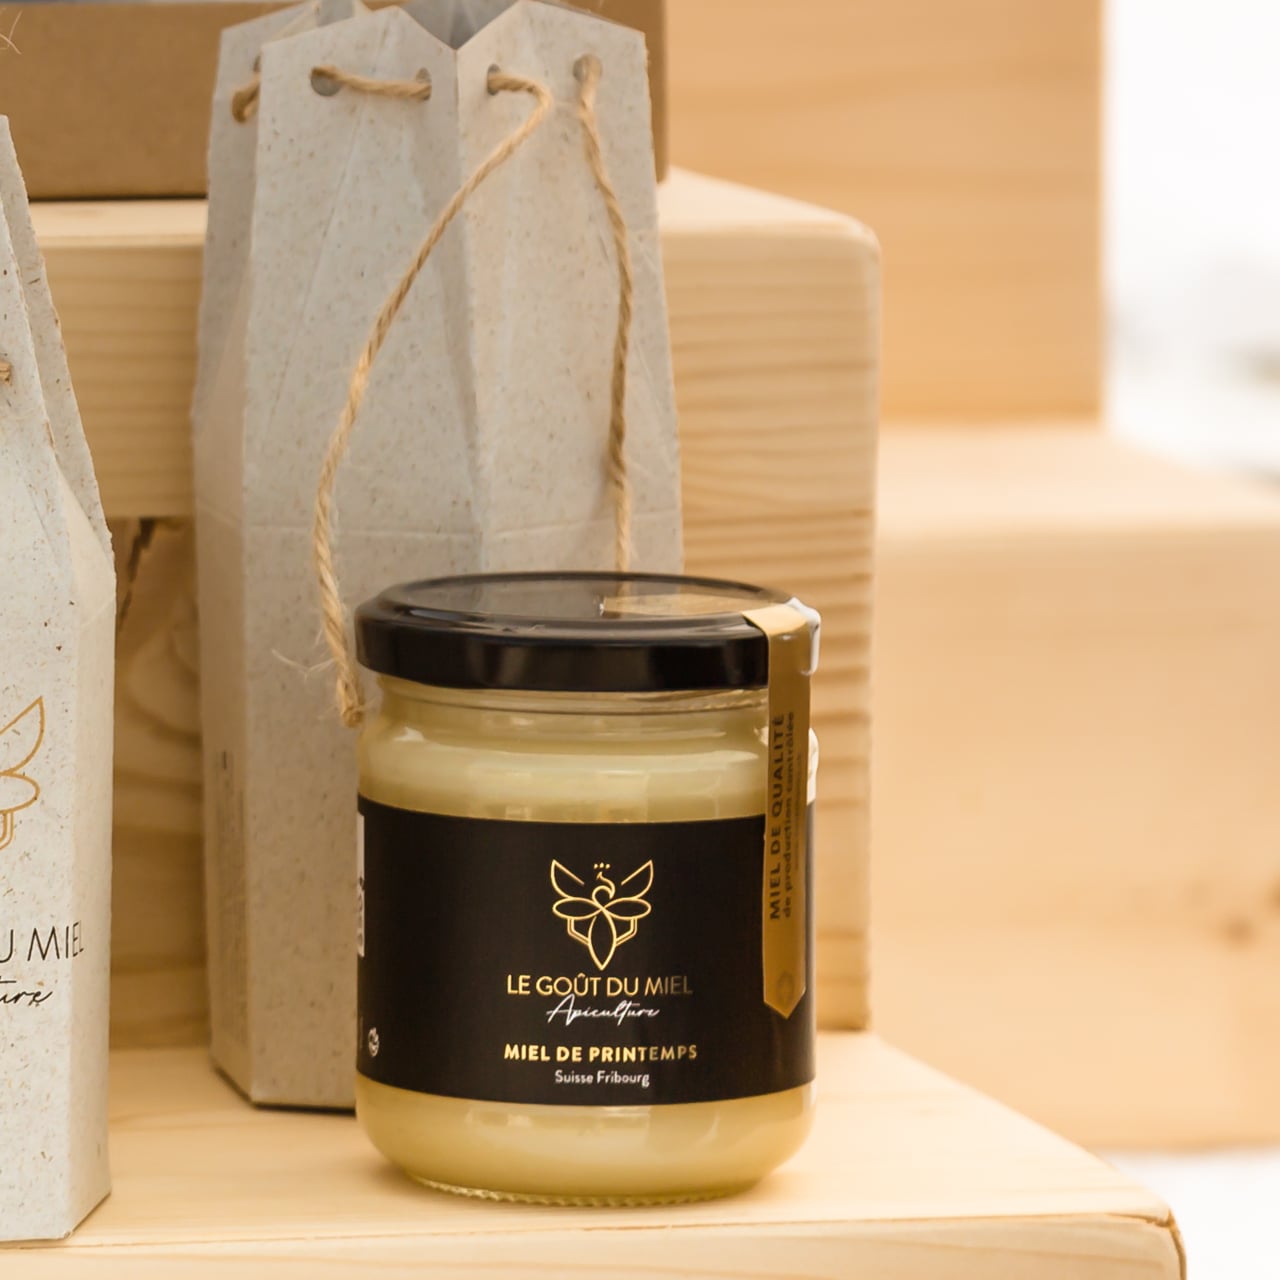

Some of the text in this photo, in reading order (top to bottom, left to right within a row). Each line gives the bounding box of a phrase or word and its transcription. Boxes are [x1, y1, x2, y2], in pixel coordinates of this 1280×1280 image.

[770, 826, 781, 856] DE
[769, 861, 781, 921] MIEL
[27, 920, 84, 963] MIEL
[506, 972, 693, 998] LE GOÛT DU MIEL
[546, 993, 660, 1026] Apiculture
[503, 1043, 698, 1063] MIEL DE PRINTEMPS
[554, 1069, 651, 1088] Suisse Fribourg
